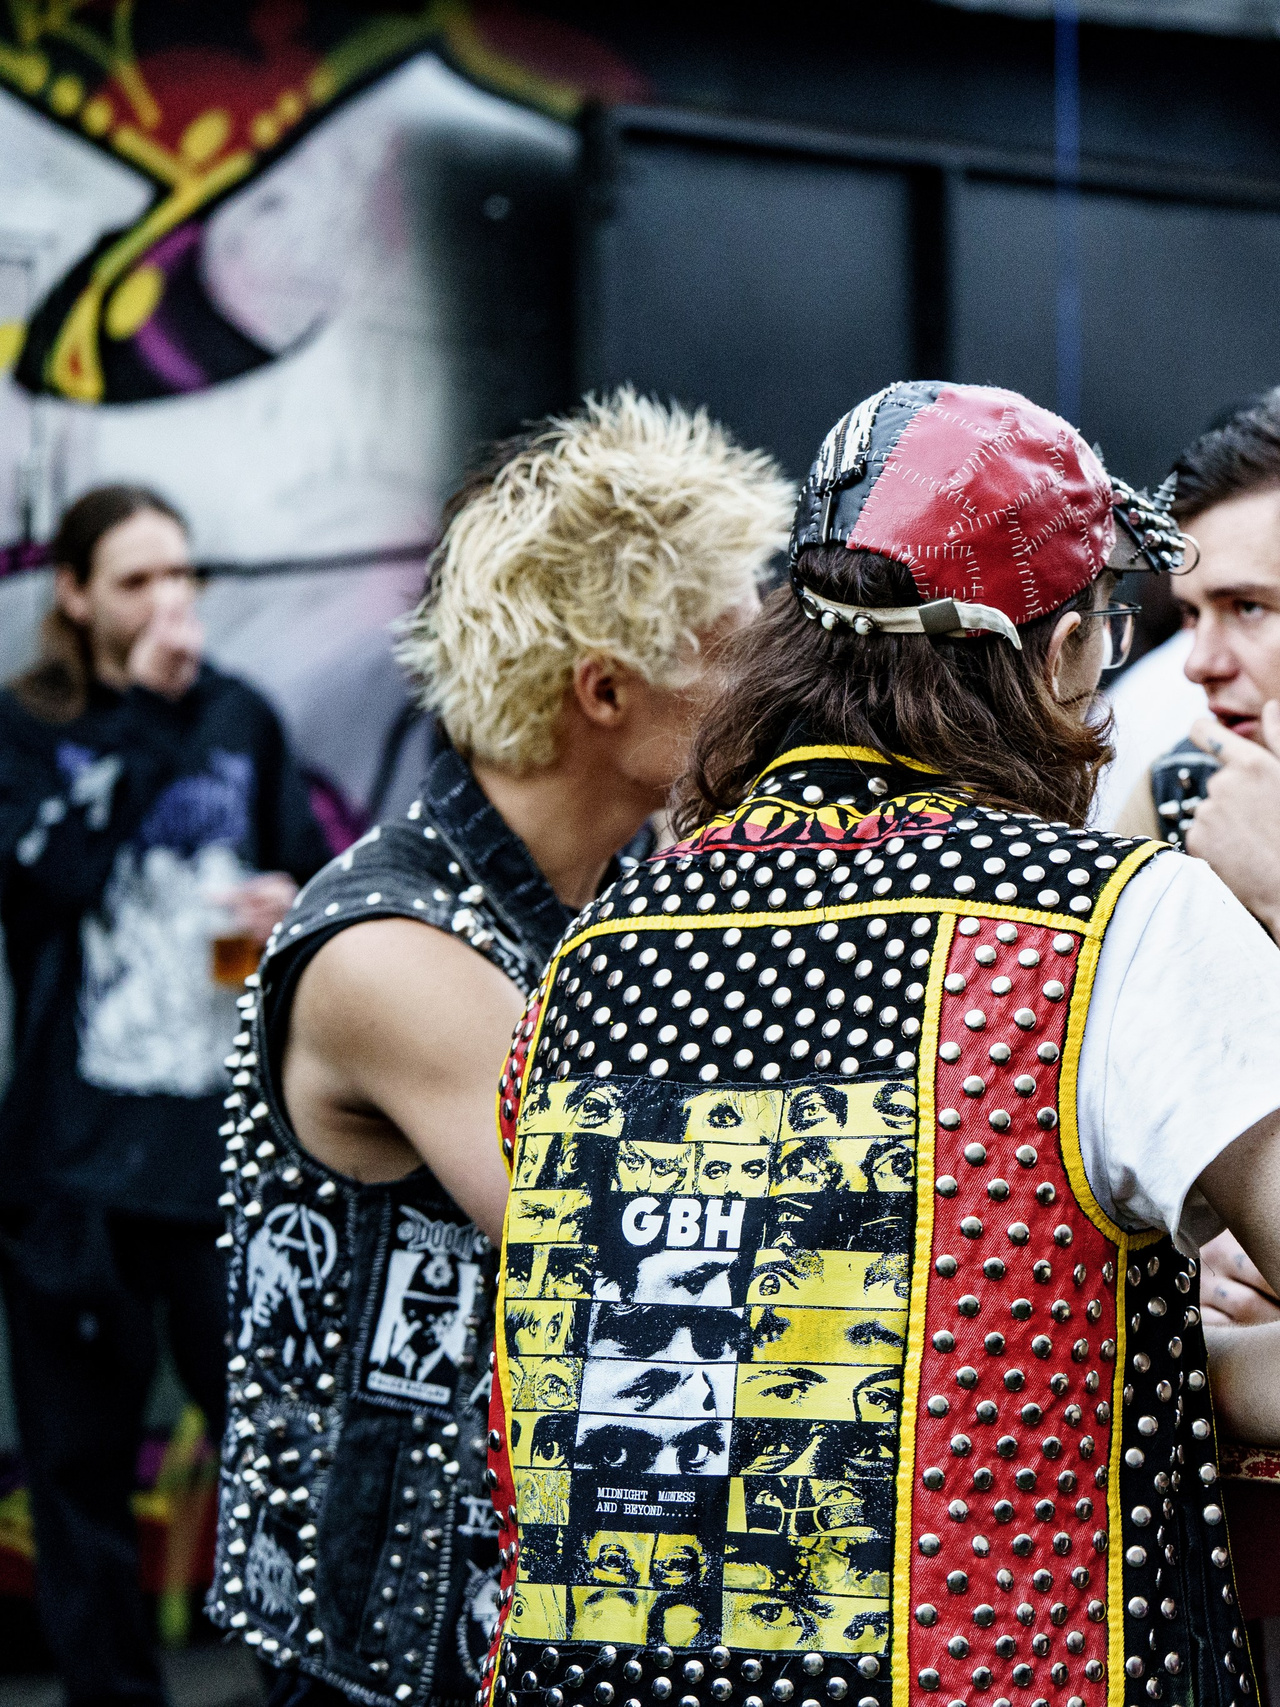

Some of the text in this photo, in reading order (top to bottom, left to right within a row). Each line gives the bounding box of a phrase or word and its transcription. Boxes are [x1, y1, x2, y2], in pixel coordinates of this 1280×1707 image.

[621, 1196, 746, 1249] GBH
[596, 1486, 649, 1501] MIDNIGHT
[595, 1501, 618, 1513] AND
